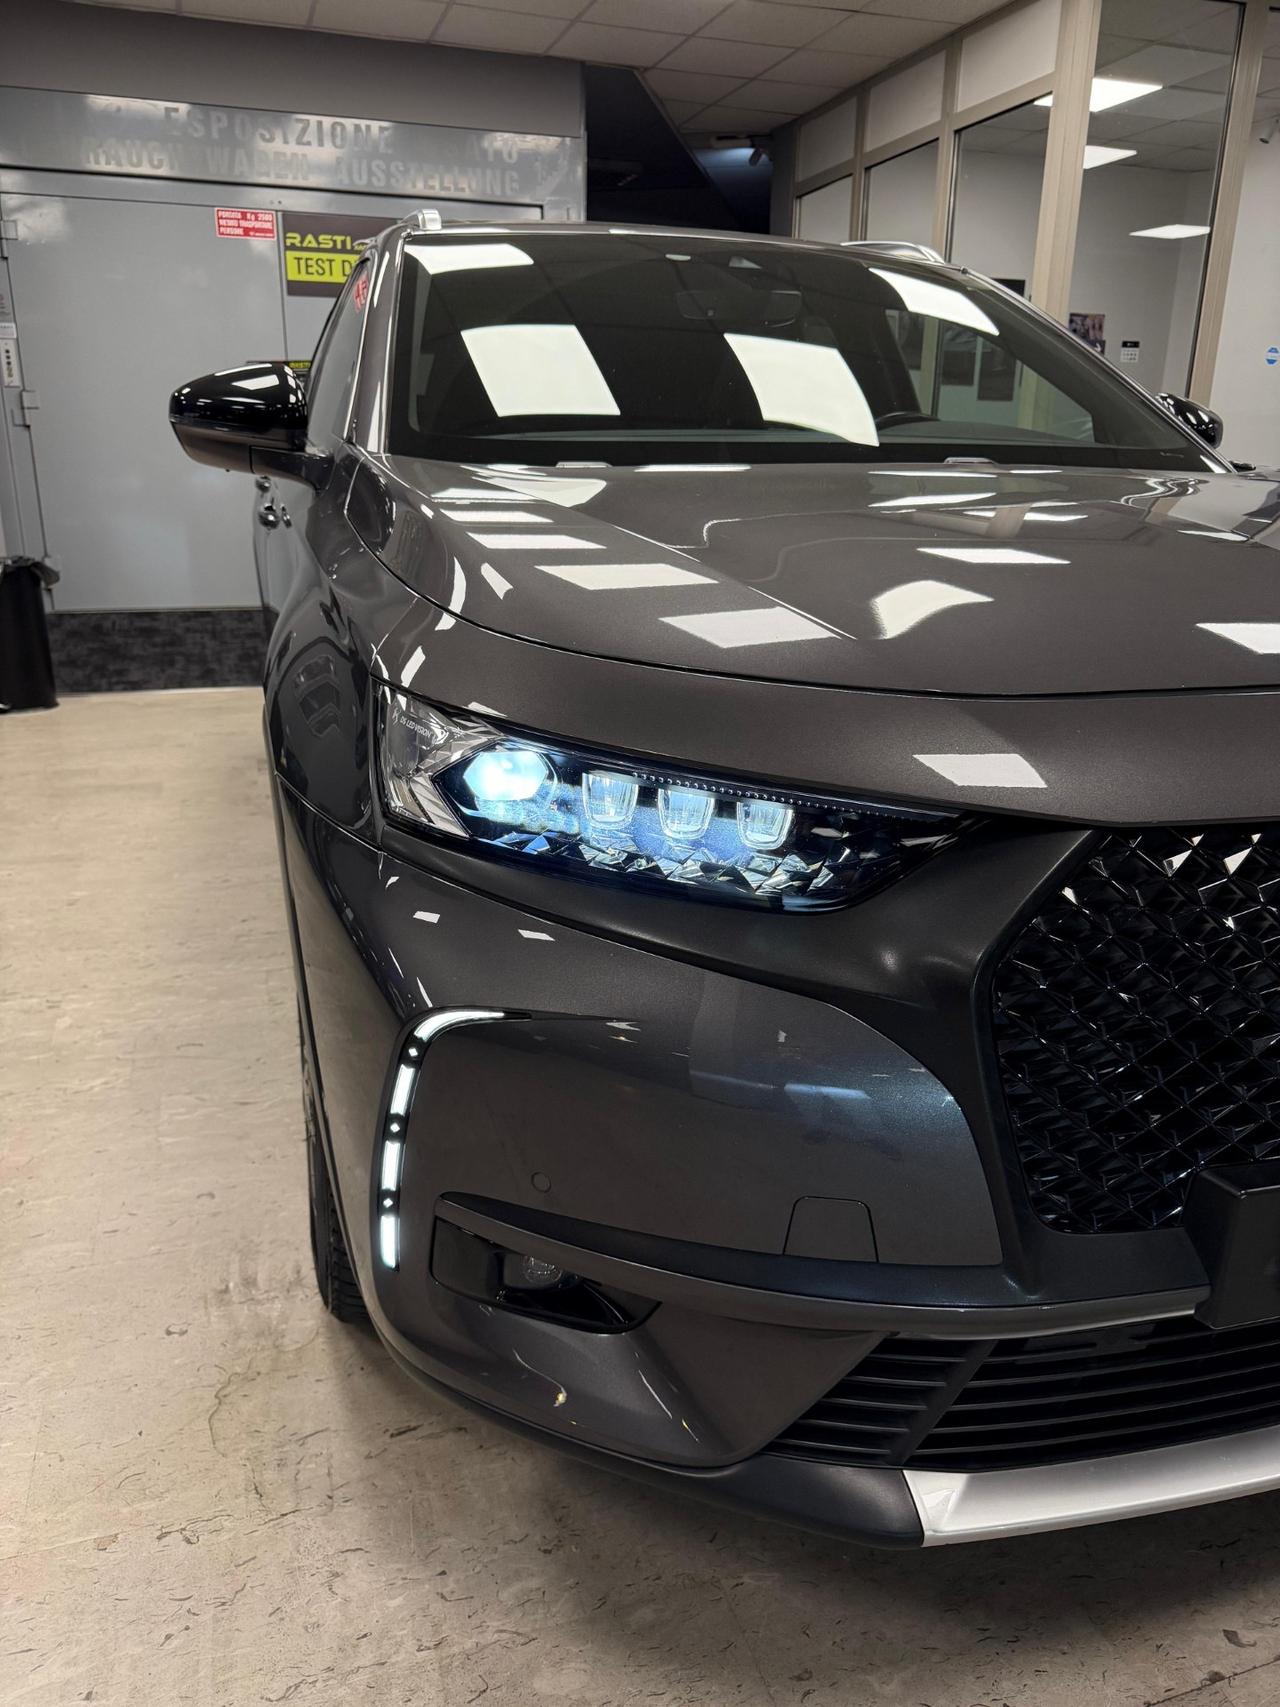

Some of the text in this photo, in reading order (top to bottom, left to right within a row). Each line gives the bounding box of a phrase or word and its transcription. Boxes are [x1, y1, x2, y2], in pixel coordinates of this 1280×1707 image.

[163, 106, 392, 154] ESPOSIZIONE
[285, 232, 351, 250] RASTI
[294, 257, 335, 276] TEST
